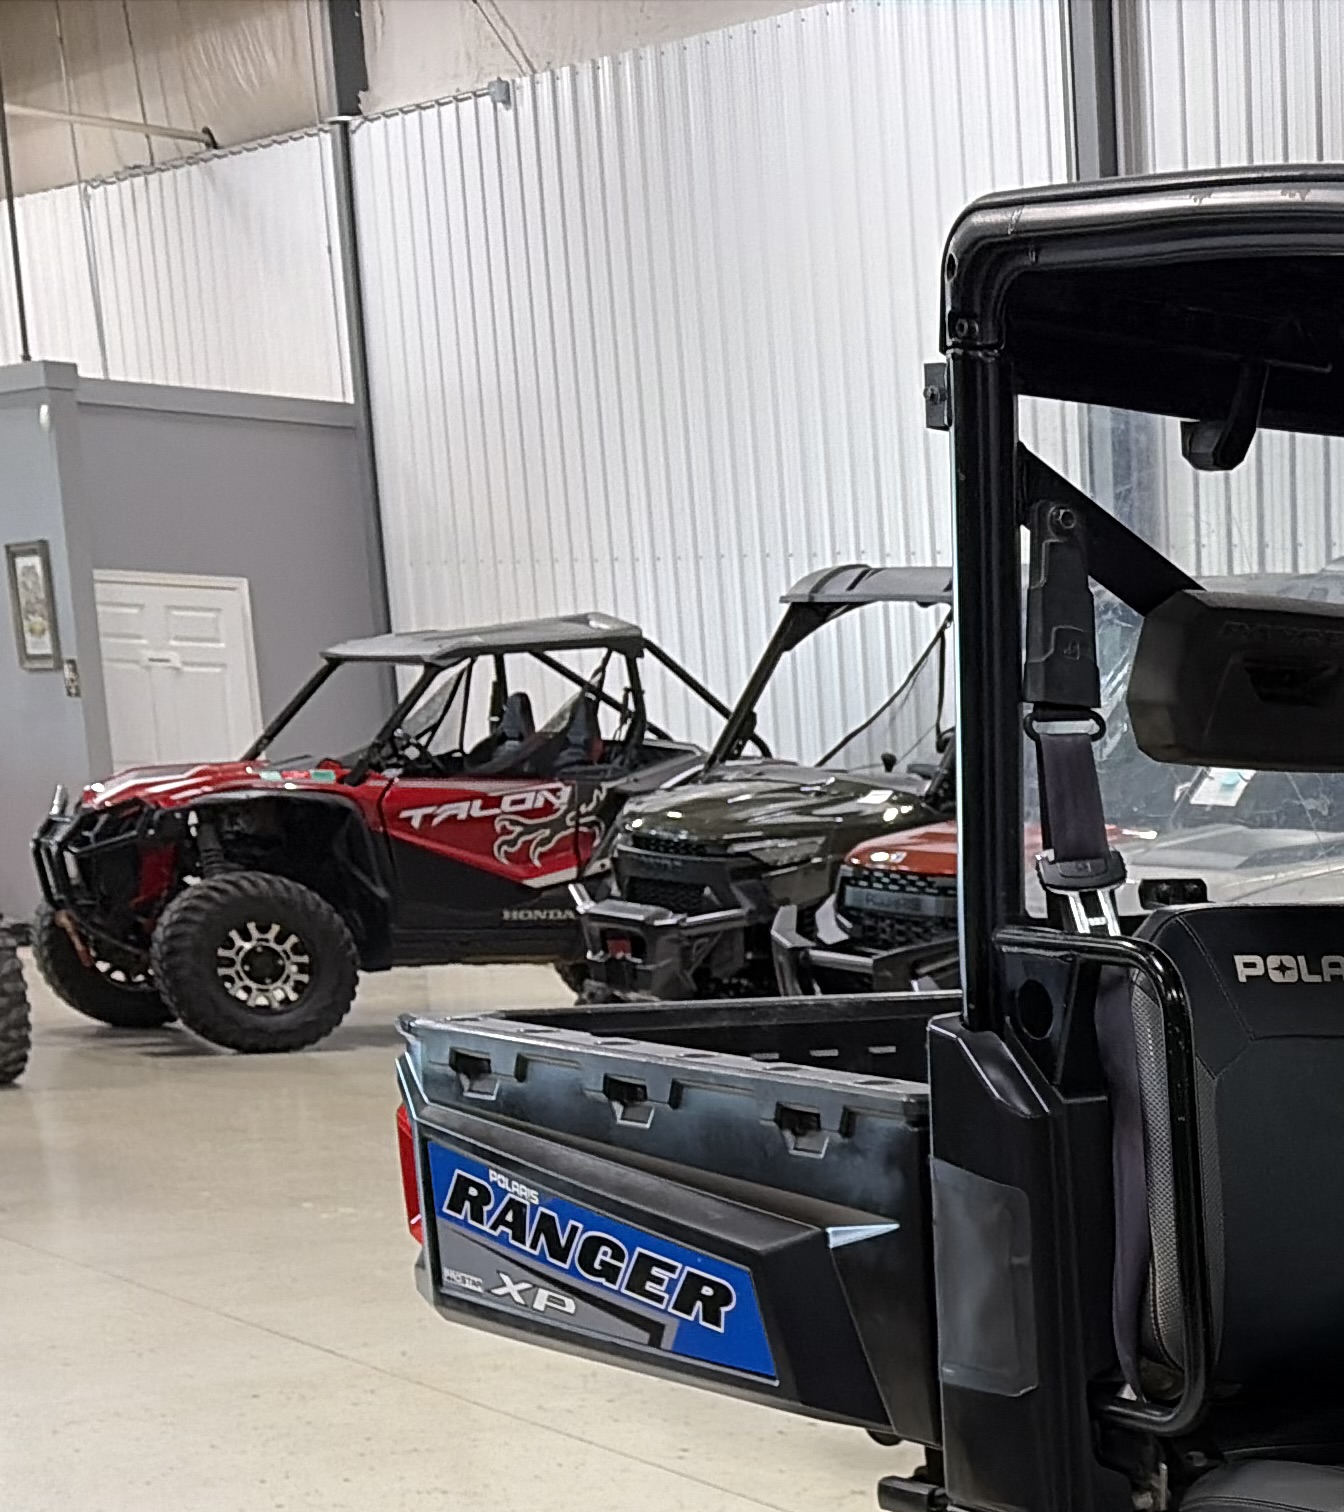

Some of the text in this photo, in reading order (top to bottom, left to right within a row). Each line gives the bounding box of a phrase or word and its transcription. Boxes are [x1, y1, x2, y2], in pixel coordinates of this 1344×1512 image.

[399, 784, 573, 830] TALON
[502, 908, 576, 921] HONDA
[488, 1168, 540, 1205] POLARIS
[442, 1168, 737, 1334] RANGER
[489, 1271, 577, 1315] XP
